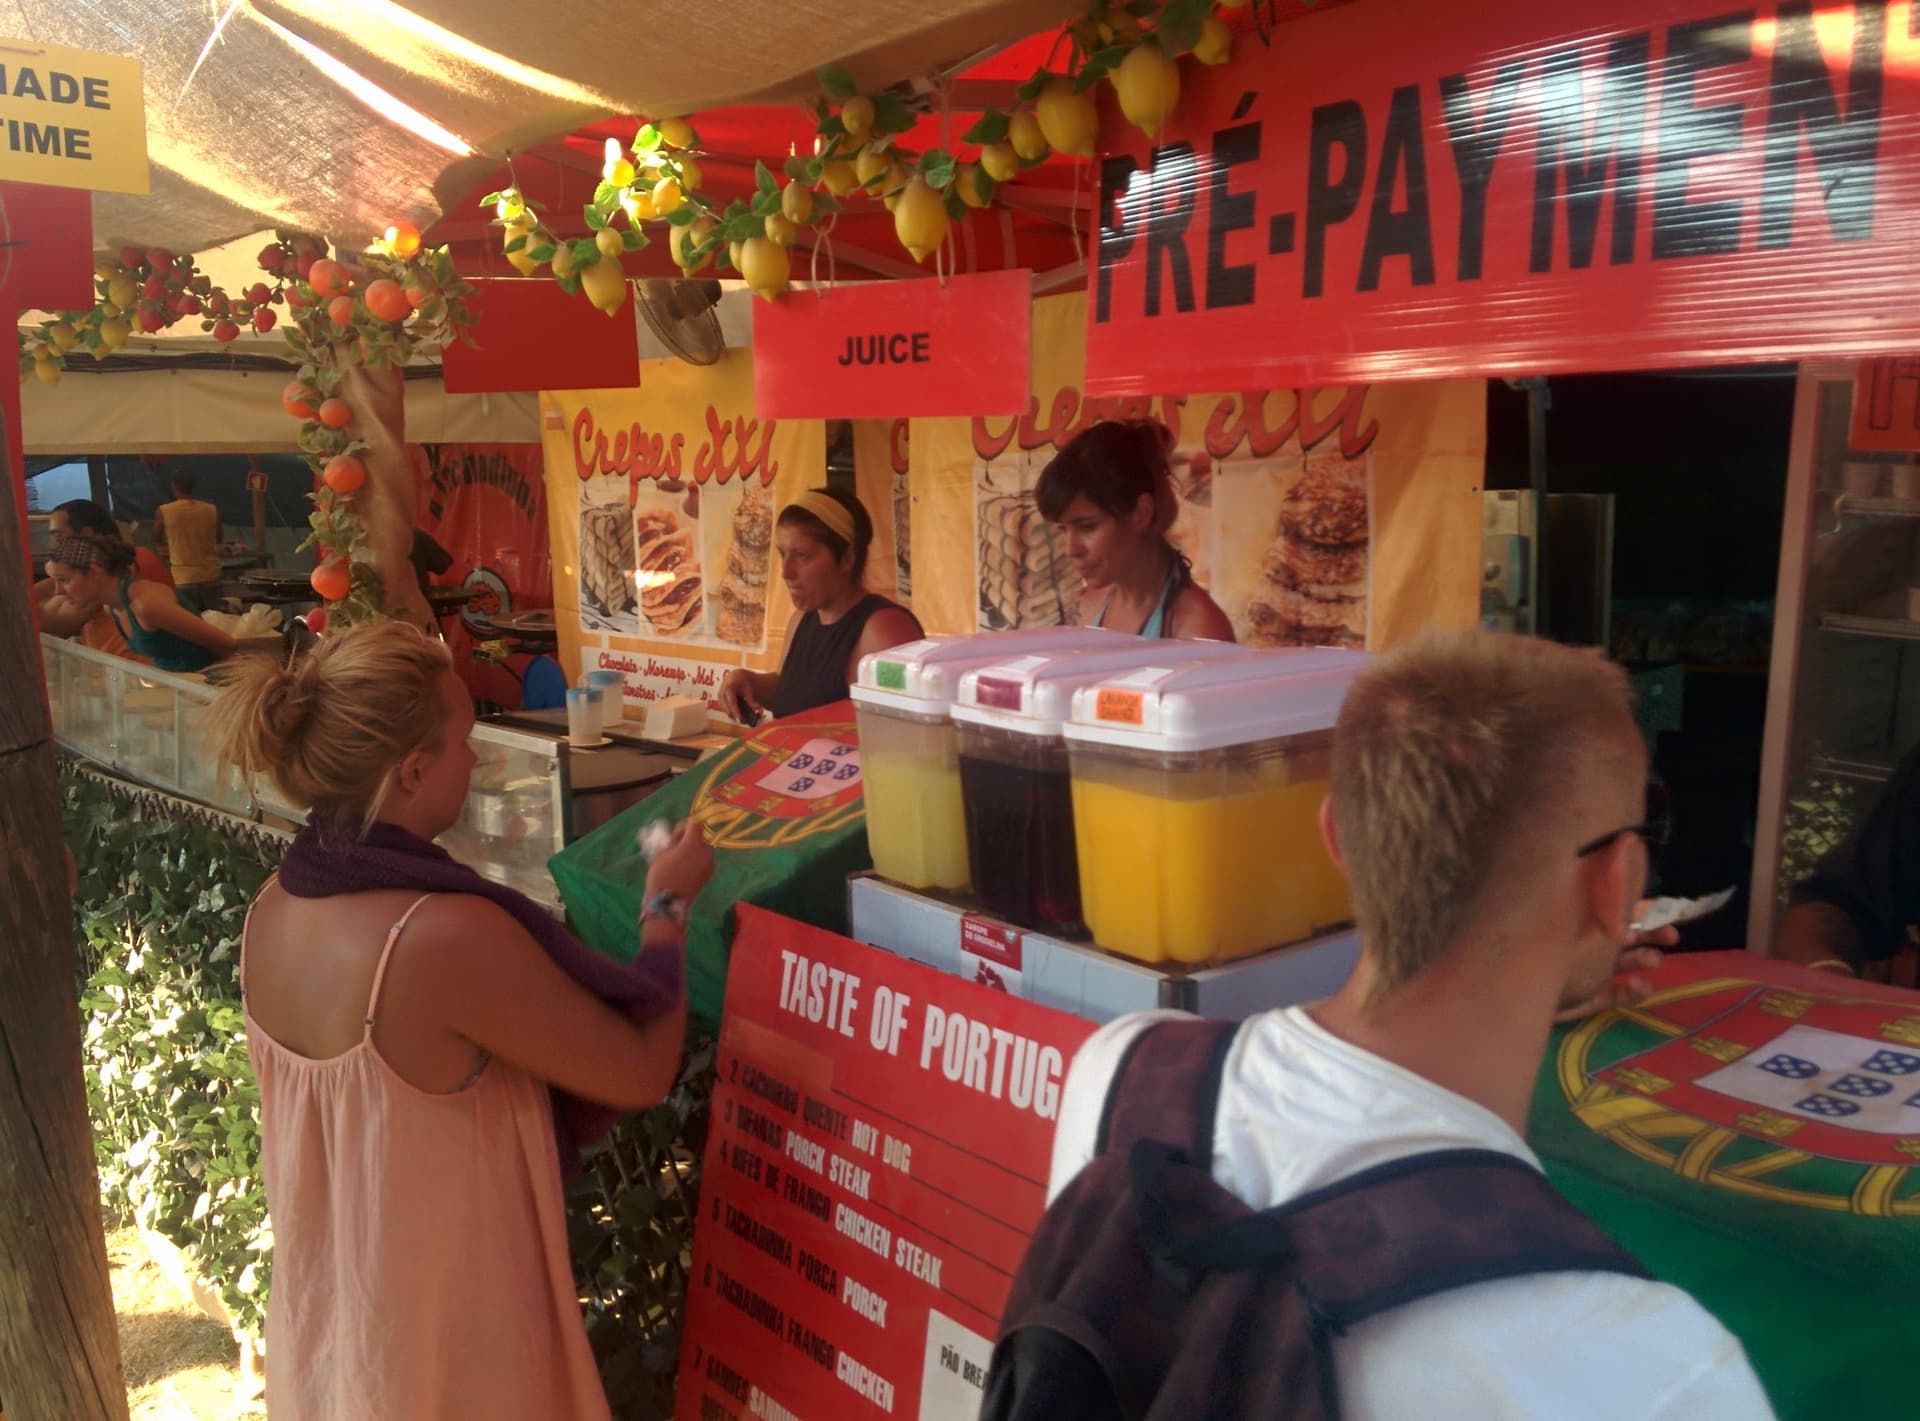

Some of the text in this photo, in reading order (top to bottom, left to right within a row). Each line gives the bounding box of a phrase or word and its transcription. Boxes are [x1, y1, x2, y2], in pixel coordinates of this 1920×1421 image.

[0, 118, 92, 160] IME
[1095, 0, 1920, 323] PRÉ-PAYMEN
[837, 332, 931, 367] JUICE
[573, 407, 685, 510] Crepes
[779, 949, 860, 1038] TASTE
[870, 985, 910, 1055] OF
[725, 1098, 734, 1124] 3
[785, 1129, 826, 1176] PORCK
[829, 1153, 871, 1200] STEAK
[729, 1058, 739, 1083] 2
[852, 1119, 880, 1157] HOT
[882, 1134, 912, 1174] DOG
[834, 1202, 892, 1260] CHICKEN
[895, 1236, 943, 1289] STEAK
[842, 1275, 888, 1329] PORCK
[836, 1351, 895, 1414] CHICKEN
[940, 1344, 960, 1374] PÃO
